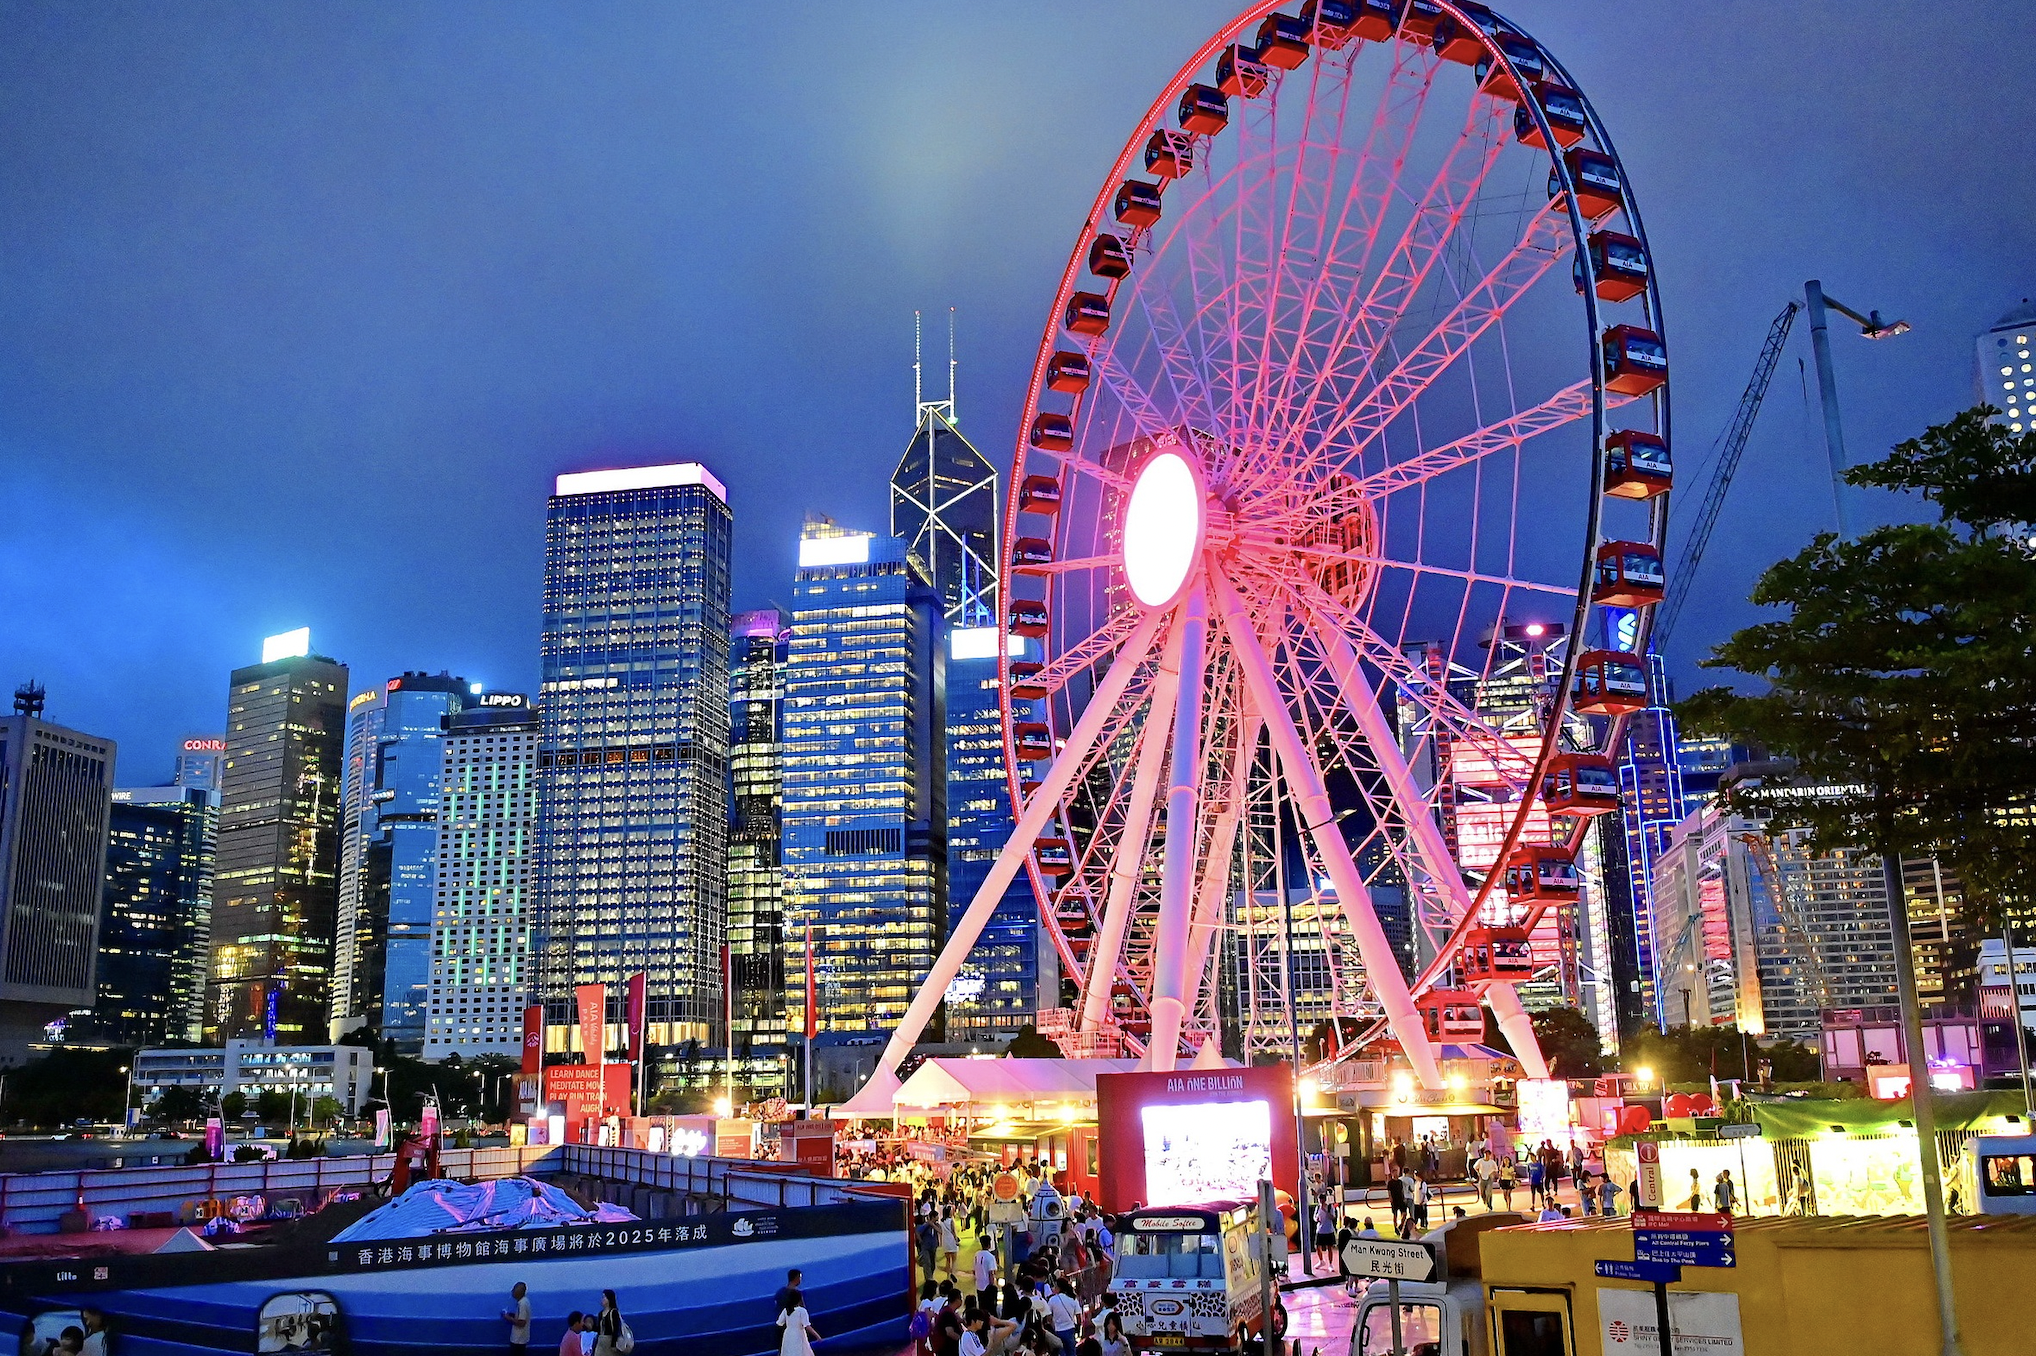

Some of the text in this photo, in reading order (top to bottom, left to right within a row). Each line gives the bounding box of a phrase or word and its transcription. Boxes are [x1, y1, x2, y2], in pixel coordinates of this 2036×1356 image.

[480, 695, 521, 706] LIPPO
[590, 1002, 598, 1021] AIA
[550, 1069, 599, 1079] LEARN DANCE
[550, 1081, 584, 1090] MEDITATE
[1168, 1079, 1184, 1091] AIA
[1646, 1166, 1657, 1201] Central
[1141, 1218, 1196, 1229] Mobile Softee
[358, 1223, 708, 1265] 香港海事博物館海事廣場將於2025年落成
[1350, 1244, 1423, 1259] Man Kwong Street
[1370, 1260, 1404, 1275] 民光街
